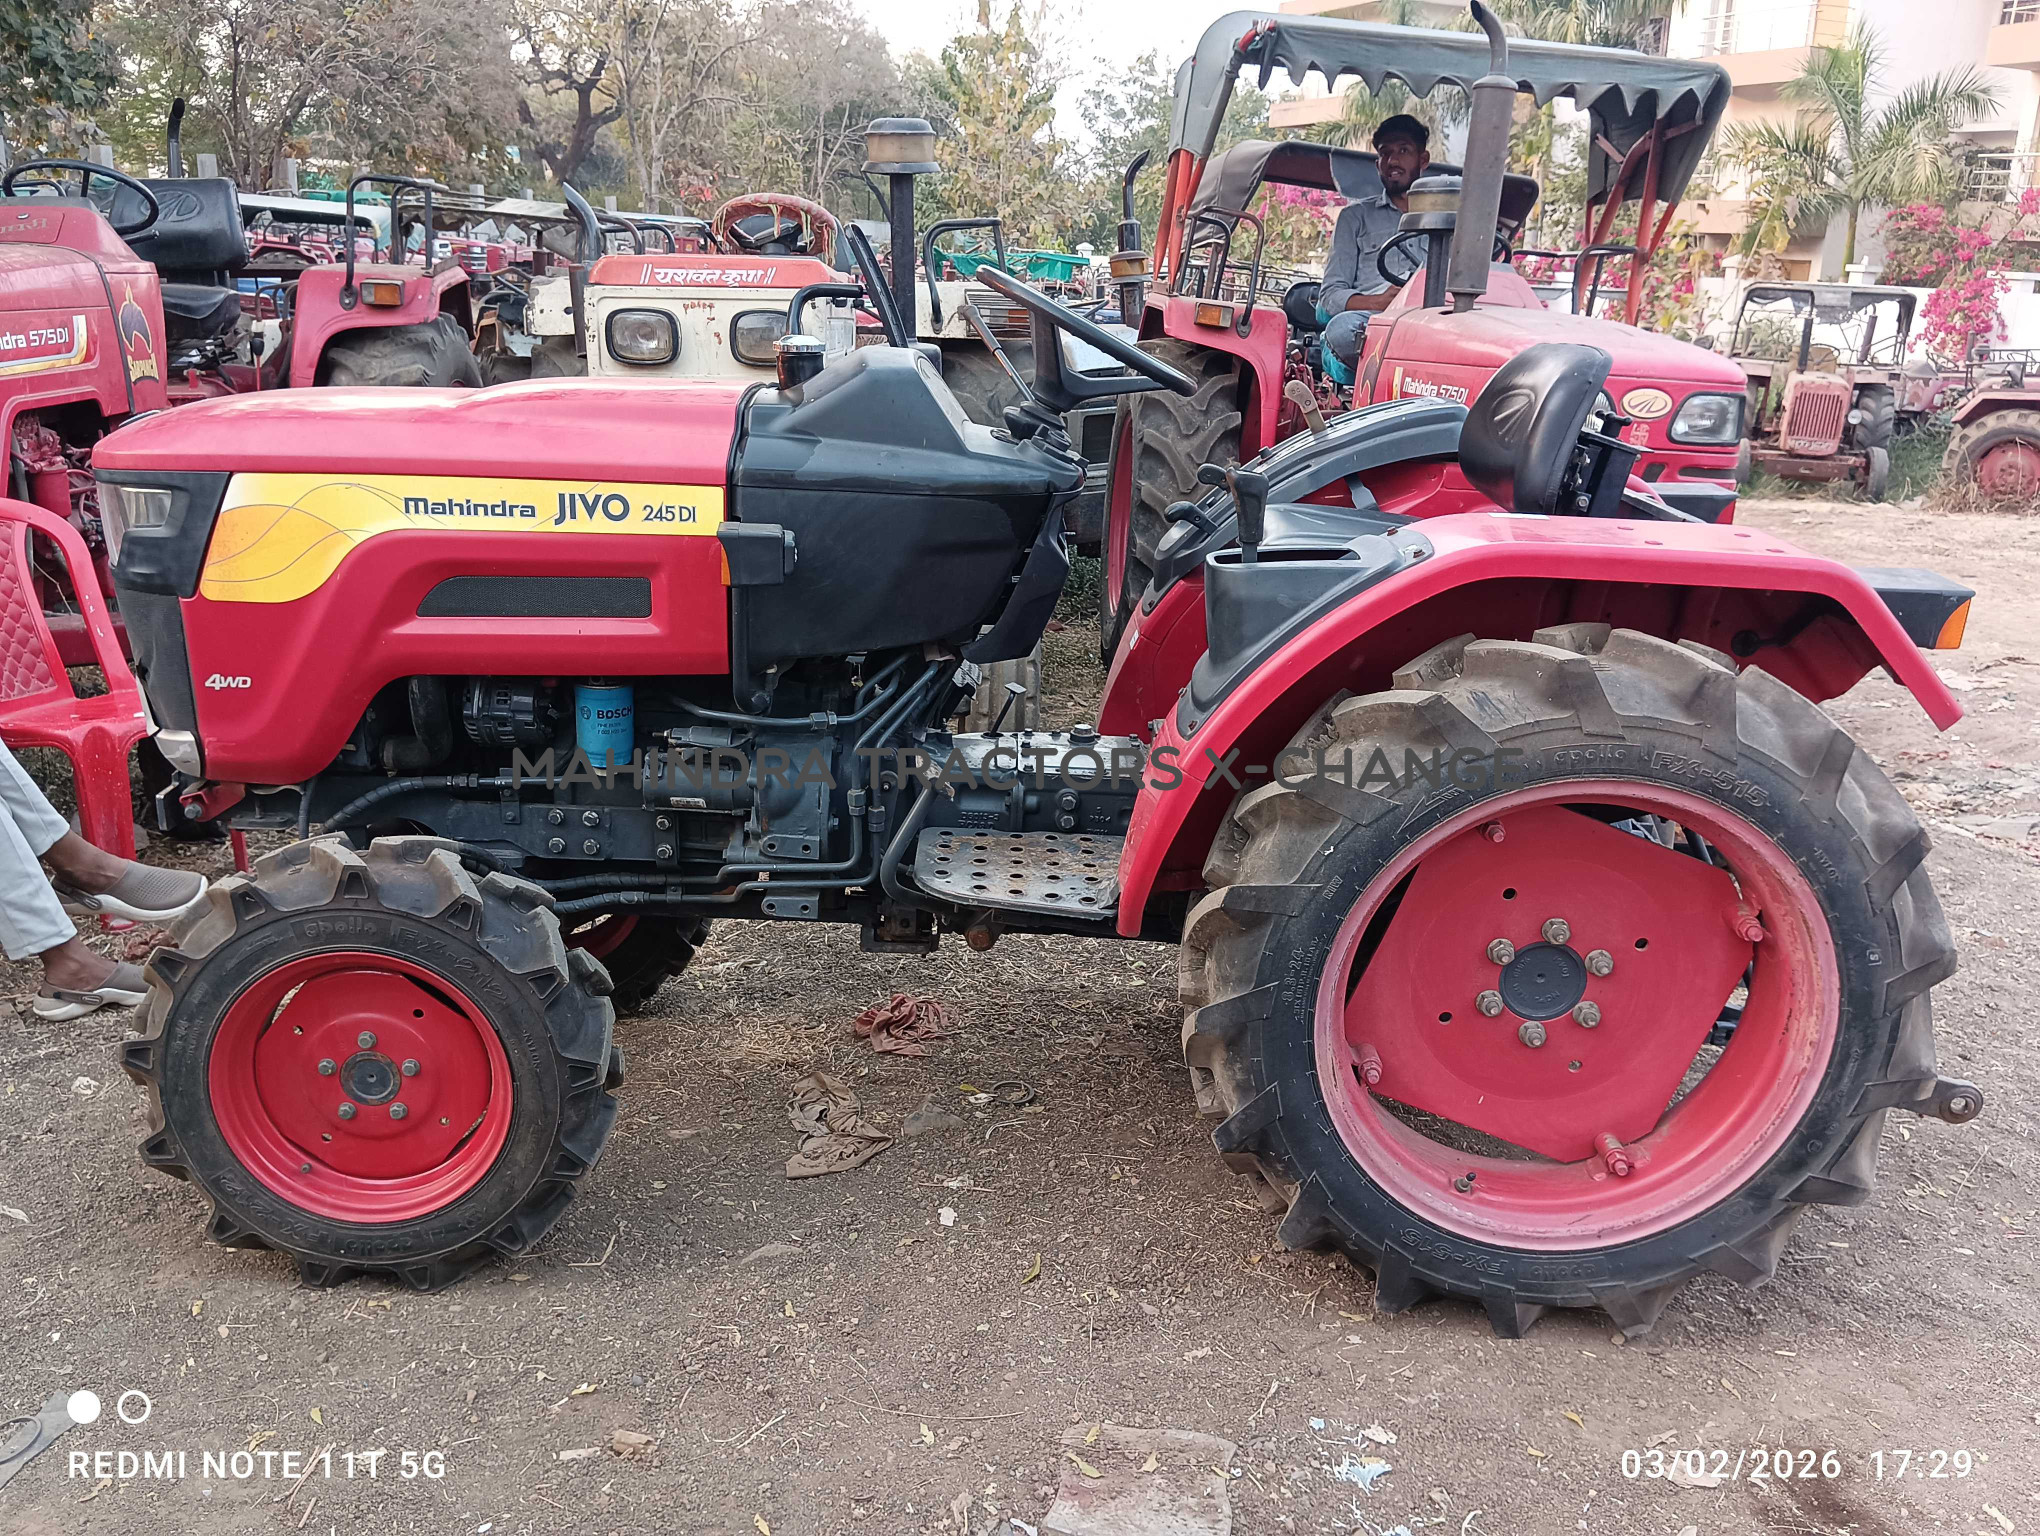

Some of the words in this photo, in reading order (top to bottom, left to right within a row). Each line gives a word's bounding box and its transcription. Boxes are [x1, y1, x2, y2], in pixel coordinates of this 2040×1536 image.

[1403, 376, 1438, 397] Mahindra
[404, 497, 536, 518] Mahindra
[554, 492, 630, 525] JIVO
[205, 673, 251, 690] 4WD
[597, 705, 632, 719] BOSCH
[1650, 750, 1771, 808] FX-515
